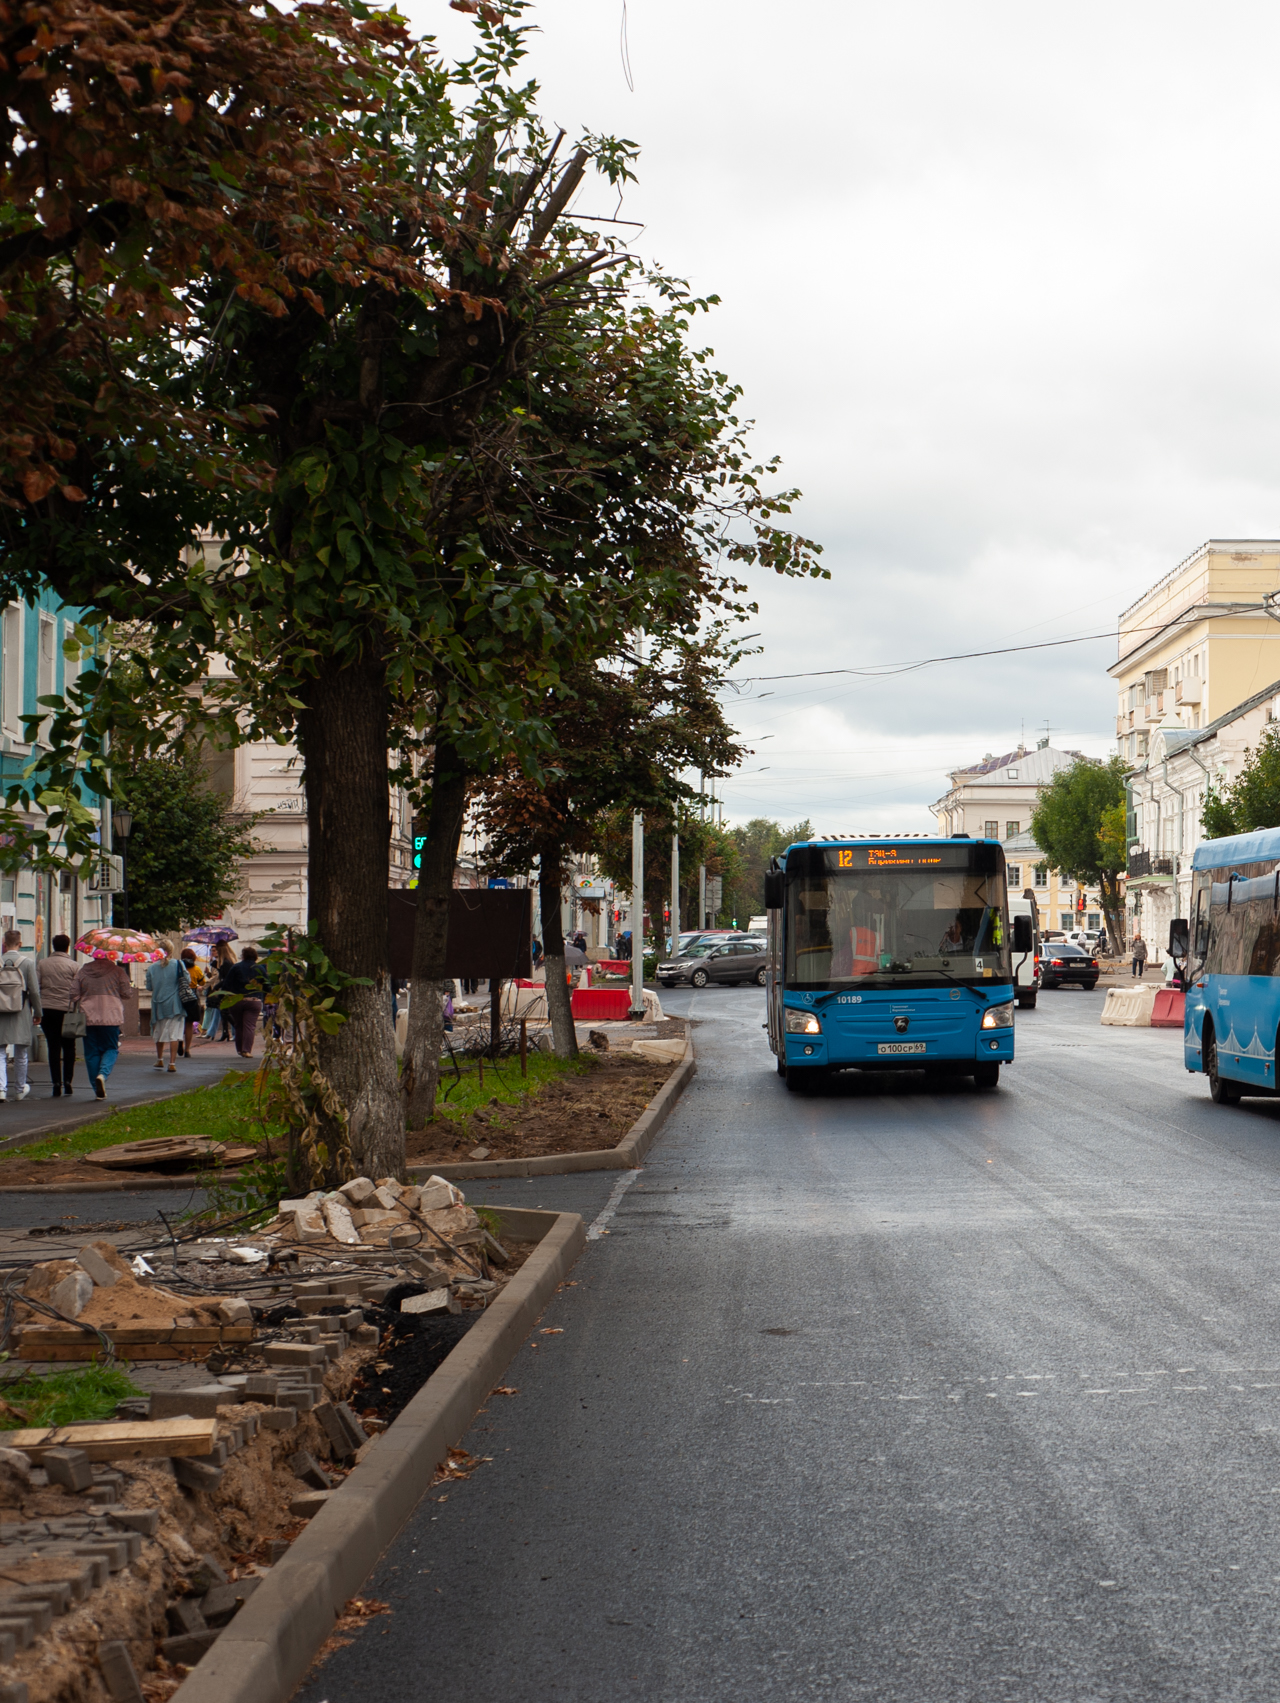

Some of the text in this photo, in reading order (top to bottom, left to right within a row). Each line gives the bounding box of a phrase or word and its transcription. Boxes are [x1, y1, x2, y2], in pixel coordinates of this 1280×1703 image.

[838, 850, 853, 867] 12
[976, 960, 982, 969] 4
[837, 996, 862, 1004] 10189
